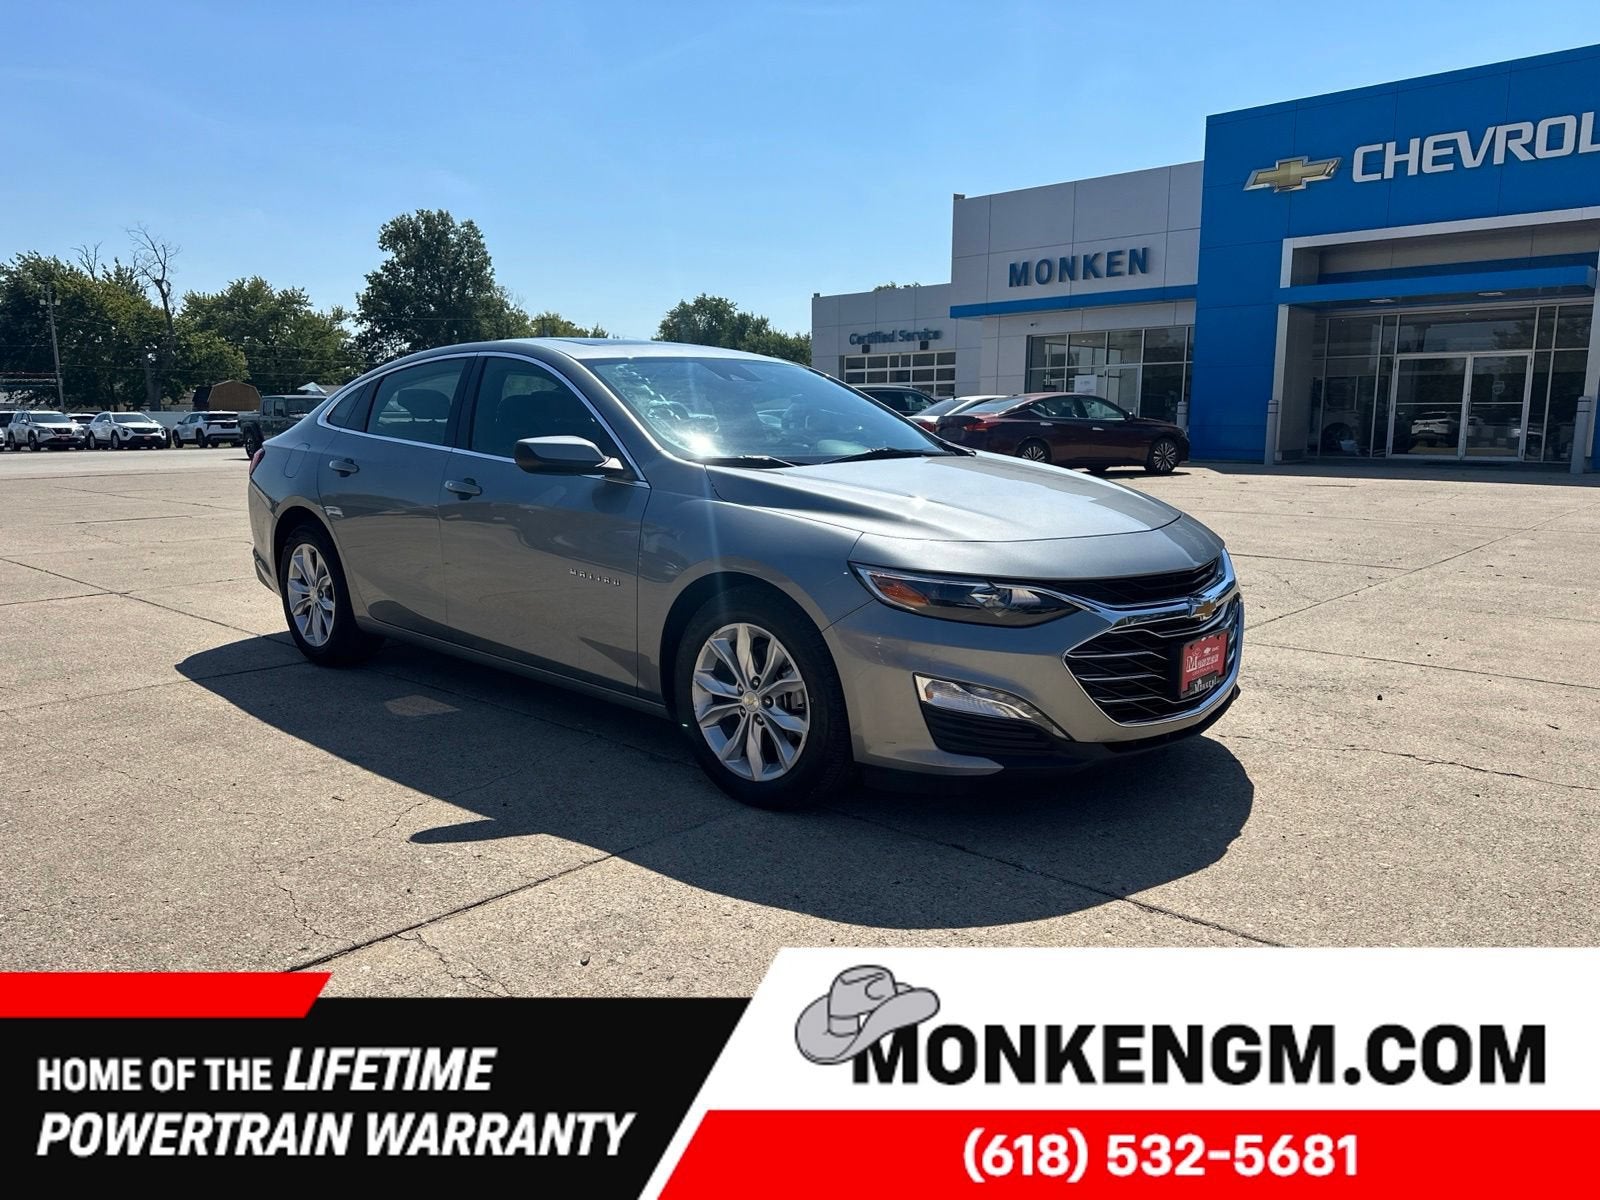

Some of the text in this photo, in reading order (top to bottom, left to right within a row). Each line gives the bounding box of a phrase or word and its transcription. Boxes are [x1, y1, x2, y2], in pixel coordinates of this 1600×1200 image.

[1353, 112, 1600, 183] CHEVROL
[1009, 247, 1150, 287] MONKEN
[849, 328, 943, 345] Certified Service
